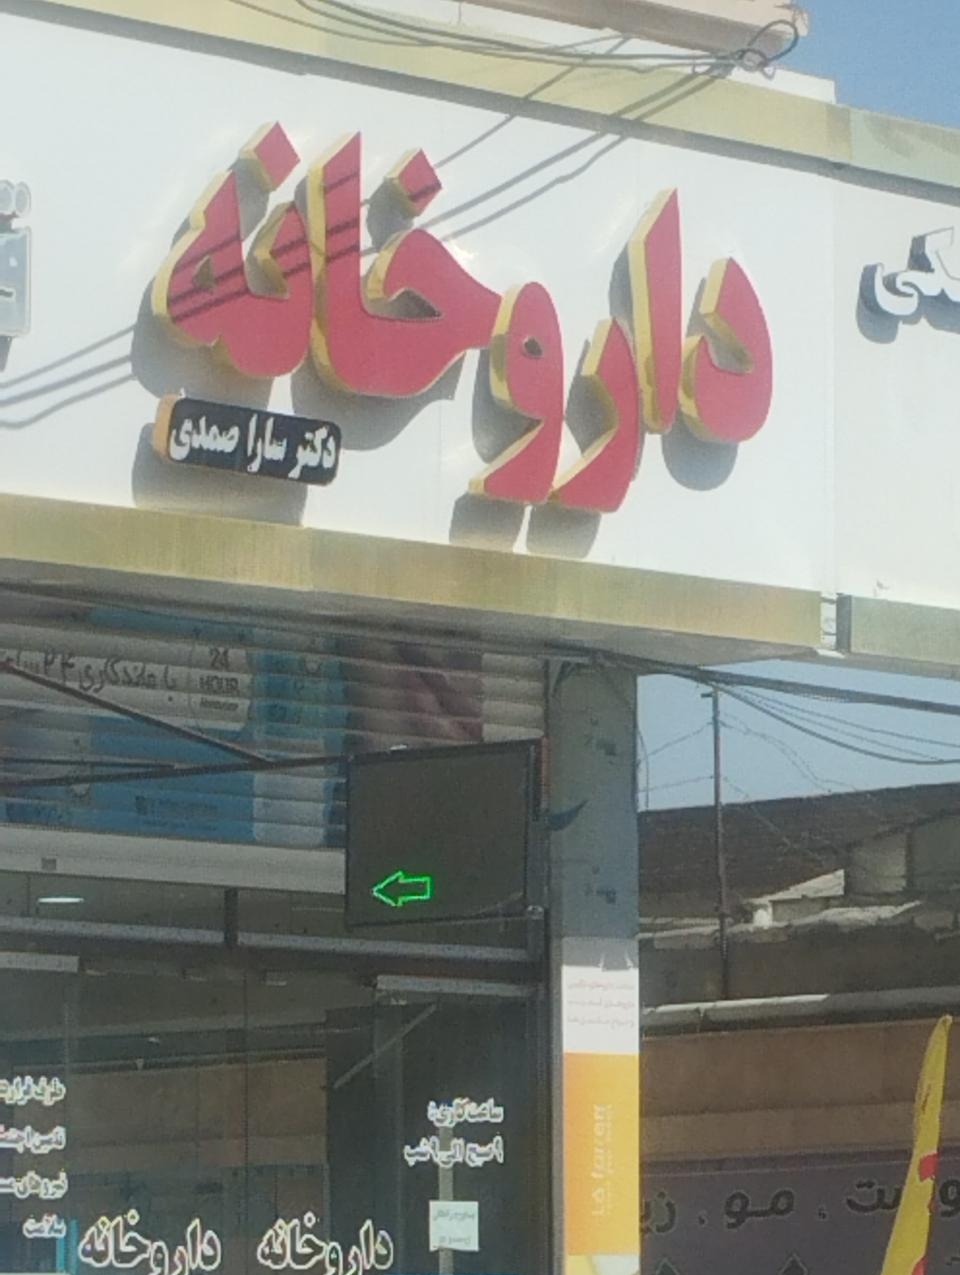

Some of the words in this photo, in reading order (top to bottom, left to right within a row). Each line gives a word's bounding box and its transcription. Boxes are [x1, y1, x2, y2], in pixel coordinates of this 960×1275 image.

[152, 120, 773, 514] داروخانه
[169, 415, 241, 461] صمدی
[247, 412, 288, 473] سارا
[287, 425, 336, 480] دکتر
[725, 1188, 796, 1230] مو
